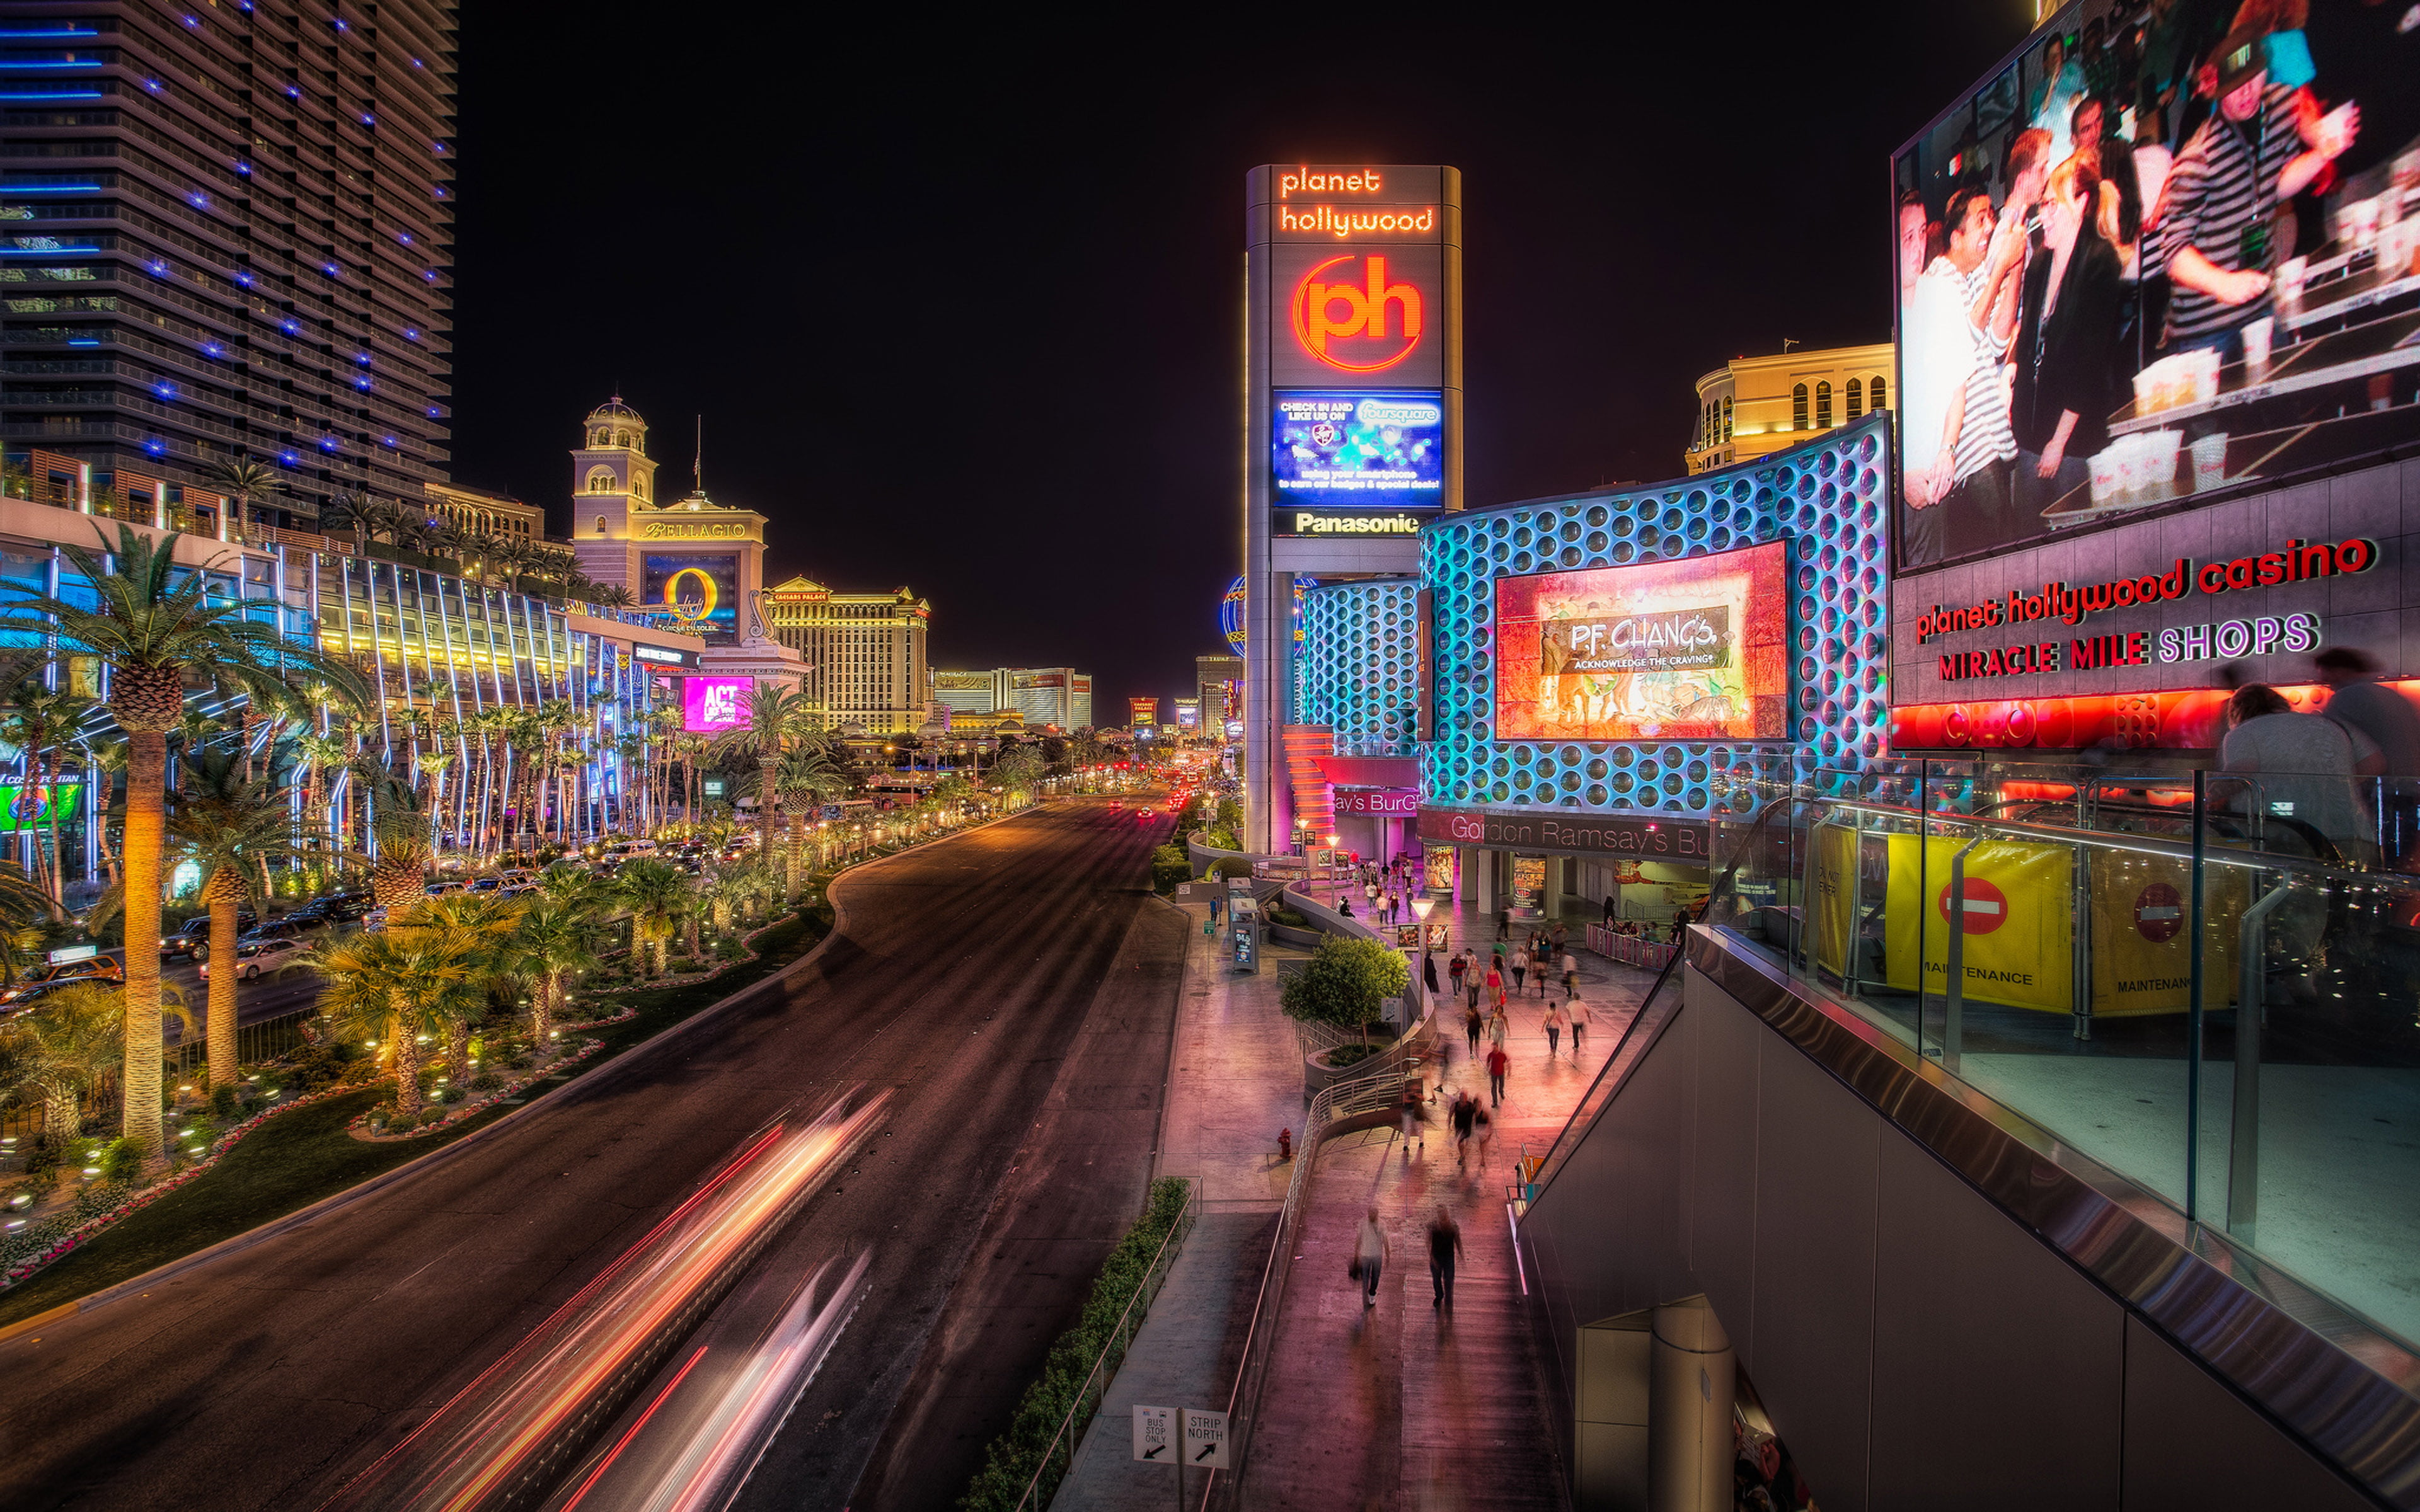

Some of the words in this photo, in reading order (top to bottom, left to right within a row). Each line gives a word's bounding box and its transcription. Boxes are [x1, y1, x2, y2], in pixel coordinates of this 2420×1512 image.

[1281, 167, 1380, 198] planet
[1282, 207, 1432, 237] hollywood
[1308, 256, 1422, 355] ph
[1281, 403, 1317, 411] CHECK
[1318, 403, 1330, 411] IN
[1331, 403, 1353, 411] AND
[1289, 412, 1311, 420] LIKE
[1313, 412, 1327, 420] US
[1330, 412, 1345, 420] ON
[1362, 403, 1438, 423] foursquare
[640, 522, 746, 539] BELLAGIO
[1296, 513, 1419, 533] Panasonic
[1917, 599, 2001, 644] planet
[2008, 558, 2186, 626] hollywood
[2198, 538, 2373, 595] casino
[1939, 641, 2056, 681] MIRACLE
[2071, 631, 2145, 670] MILE
[2159, 614, 2315, 664] SHOPS
[1574, 658, 1646, 670] ACKNOWLEDGE
[1649, 657, 1667, 667] THE
[705, 685, 738, 707] ACT
[1451, 816, 1533, 843] Gordon
[1541, 822, 1666, 856] Ramsay's
[1924, 961, 2033, 985] MAIENANCE
[1146, 1426, 1166, 1435] STOP
[1147, 1418, 1163, 1426] BUS
[1190, 1416, 1221, 1429] STRIP
[1146, 1435, 1166, 1443] ONLY
[1188, 1428, 1223, 1441] NORTH
